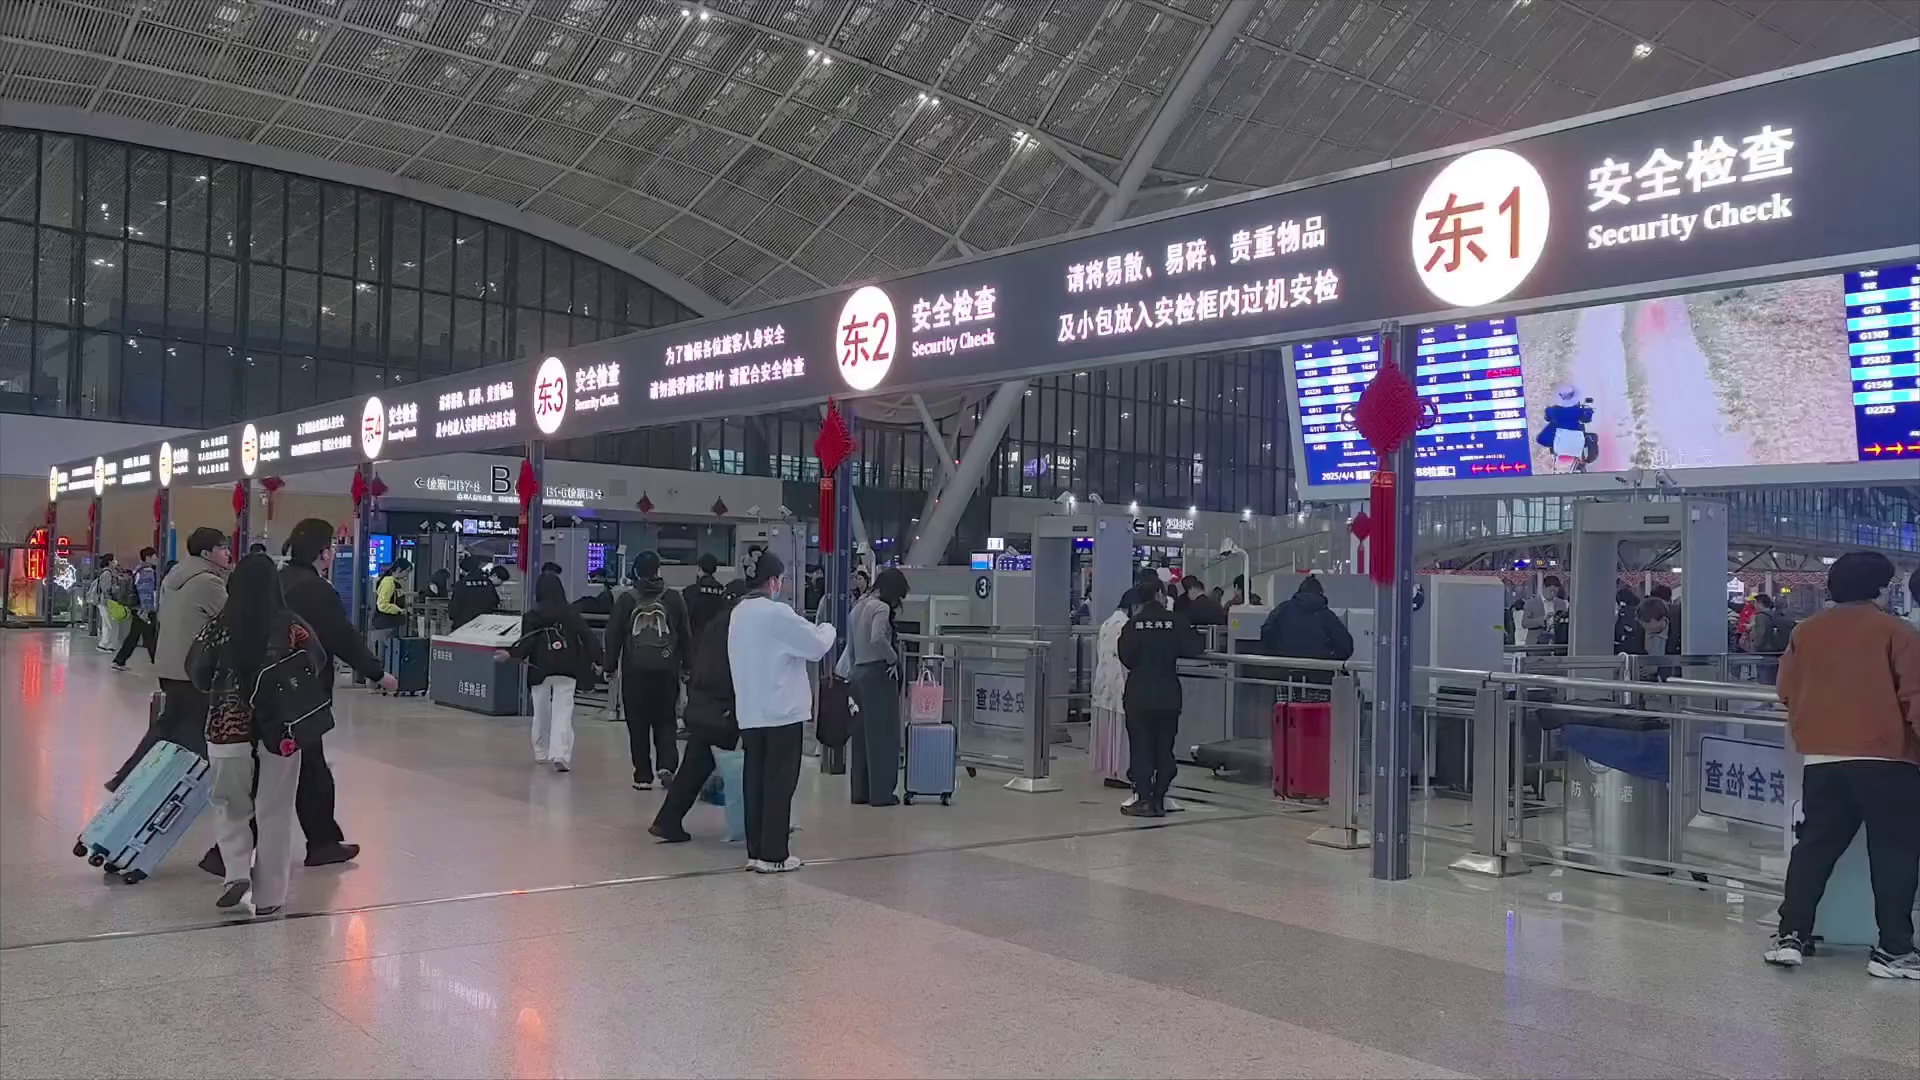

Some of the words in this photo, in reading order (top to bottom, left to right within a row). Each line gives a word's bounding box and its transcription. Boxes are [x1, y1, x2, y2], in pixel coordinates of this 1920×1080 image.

[1588, 125, 1794, 212] 安全检查
[1424, 186, 1520, 273] 东1
[1588, 212, 1698, 250] Security
[1704, 193, 1793, 232] Check
[1066, 216, 1326, 293] 请将易散、易碎、贵重物品
[912, 285, 995, 332] 安全检查
[1057, 268, 1339, 343] 及小包放入安检框内过机安检
[665, 323, 786, 366] 为了确保各位旅客人身安全
[841, 312, 889, 366] 东2
[912, 334, 957, 358] Security
[959, 328, 995, 349] Check
[575, 361, 620, 393] 安全检查
[729, 356, 805, 388] 请配合安全检查
[537, 377, 563, 415] 东3
[365, 413, 381, 442] 东4
[491, 465, 511, 494] B
[1321, 471, 1355, 481] 2025/4/4
[978, 578, 987, 596] 3
